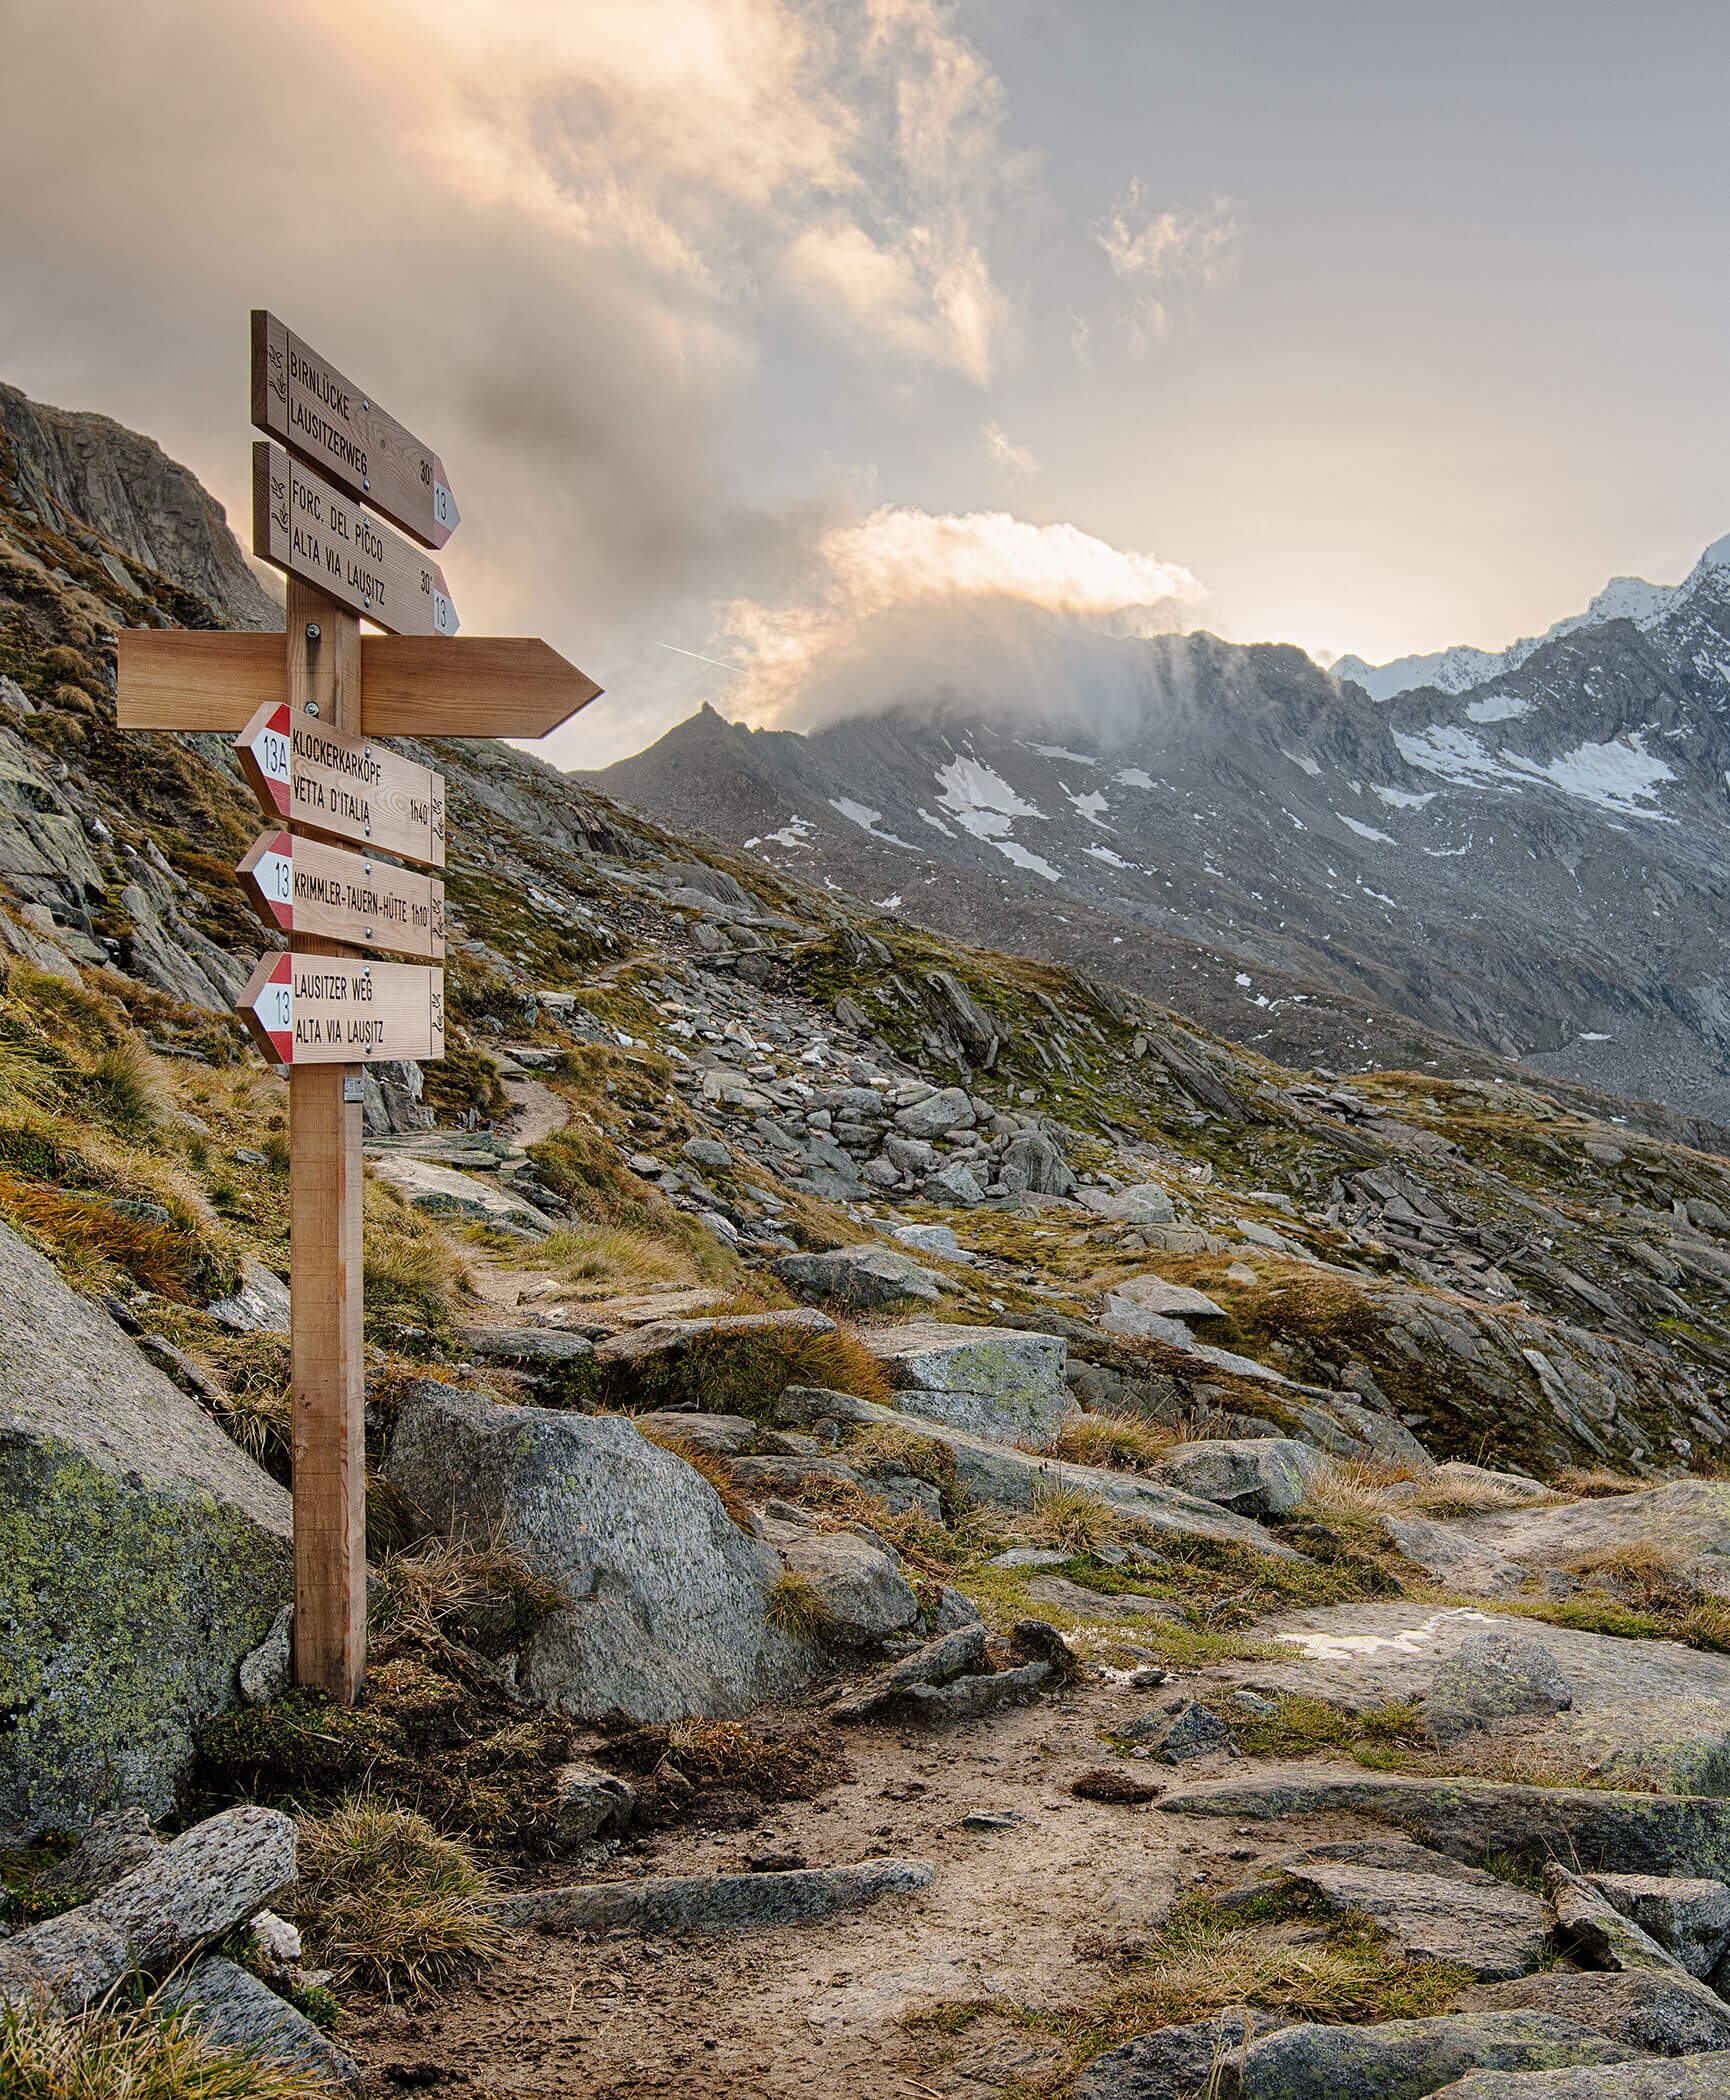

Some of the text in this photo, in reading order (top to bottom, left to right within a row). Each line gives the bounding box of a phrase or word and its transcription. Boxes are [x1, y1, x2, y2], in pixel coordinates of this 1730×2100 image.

[290, 351, 350, 421] BIRNLÜCKE
[290, 397, 368, 476] LAUSITZERWEG
[292, 479, 383, 562] FORC. DEL PICCO
[435, 487, 447, 521] 13
[293, 527, 385, 605] ALTA VIA LAUSITZ
[435, 596, 447, 628] 13
[263, 735, 288, 776] 13A
[292, 728, 381, 786] KLOCKERKARKOPF
[292, 774, 370, 825] VETTA D'ITALIA
[275, 861, 290, 898] 13
[294, 871, 407, 923] KRIMMLER-TAUERN-HÜTTE
[275, 991, 290, 1025] 13
[294, 974, 373, 1001] LAUSITZER WEG
[295, 1019, 384, 1044] ALTA VIA LAUSITZ
